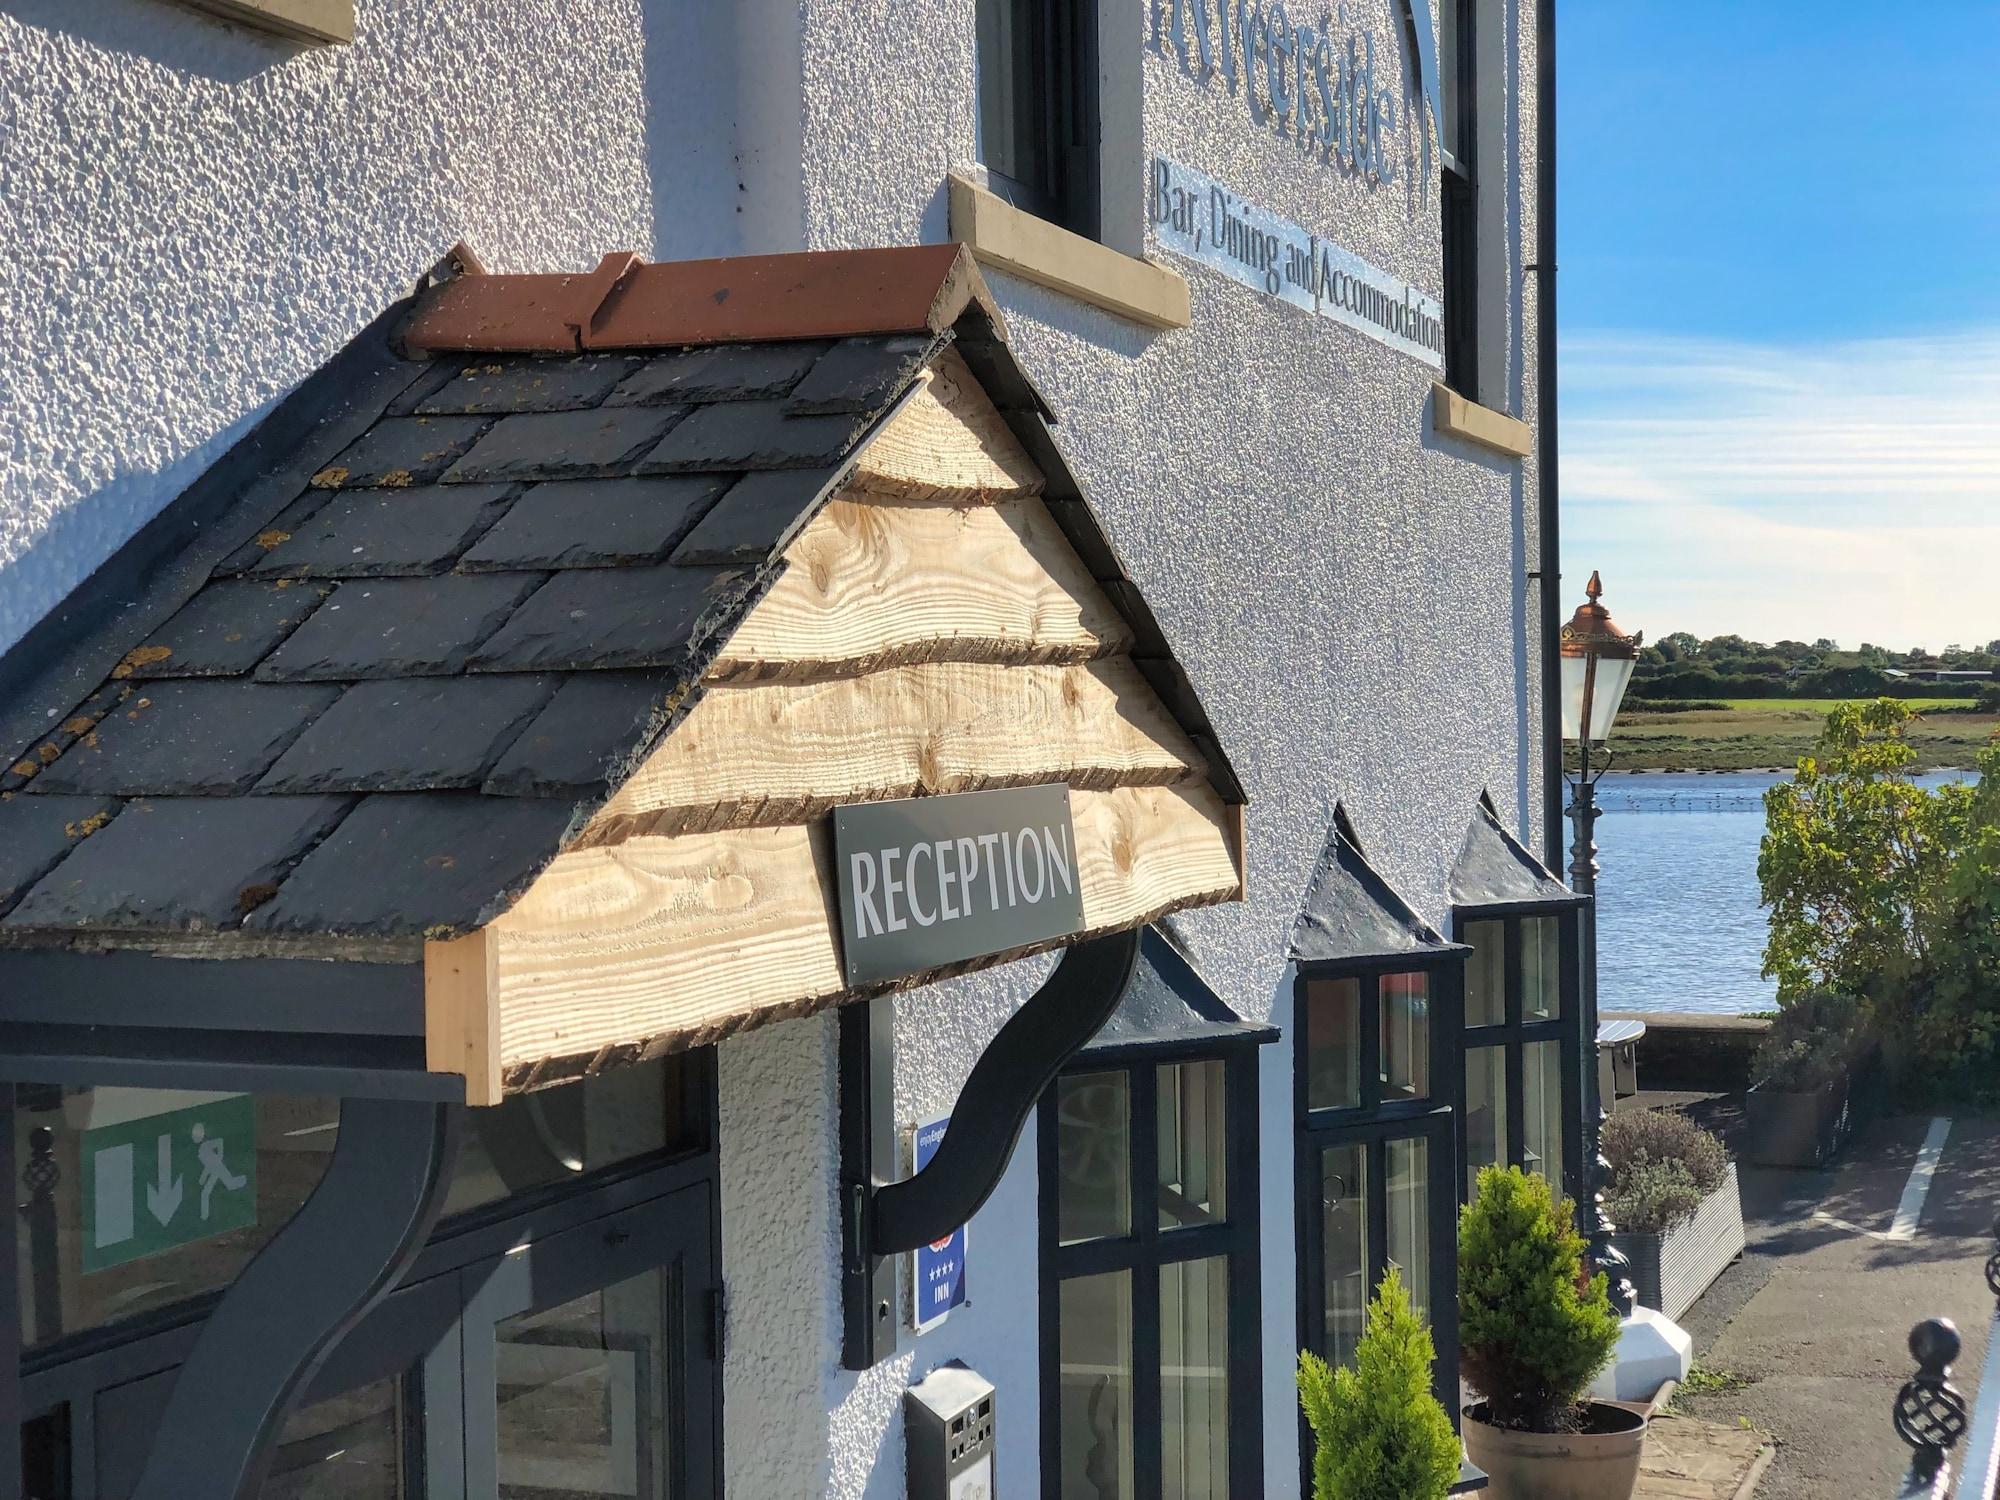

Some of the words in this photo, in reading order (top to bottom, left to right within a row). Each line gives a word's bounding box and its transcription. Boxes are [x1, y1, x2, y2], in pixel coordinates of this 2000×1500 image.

[1156, 156, 1202, 253] Bar,
[1211, 184, 1281, 296] Dining
[1286, 235, 1317, 295] and
[1319, 247, 1442, 354] Accommodation
[850, 823, 1073, 940] RECEPTION
[934, 1281, 950, 1305] INN
